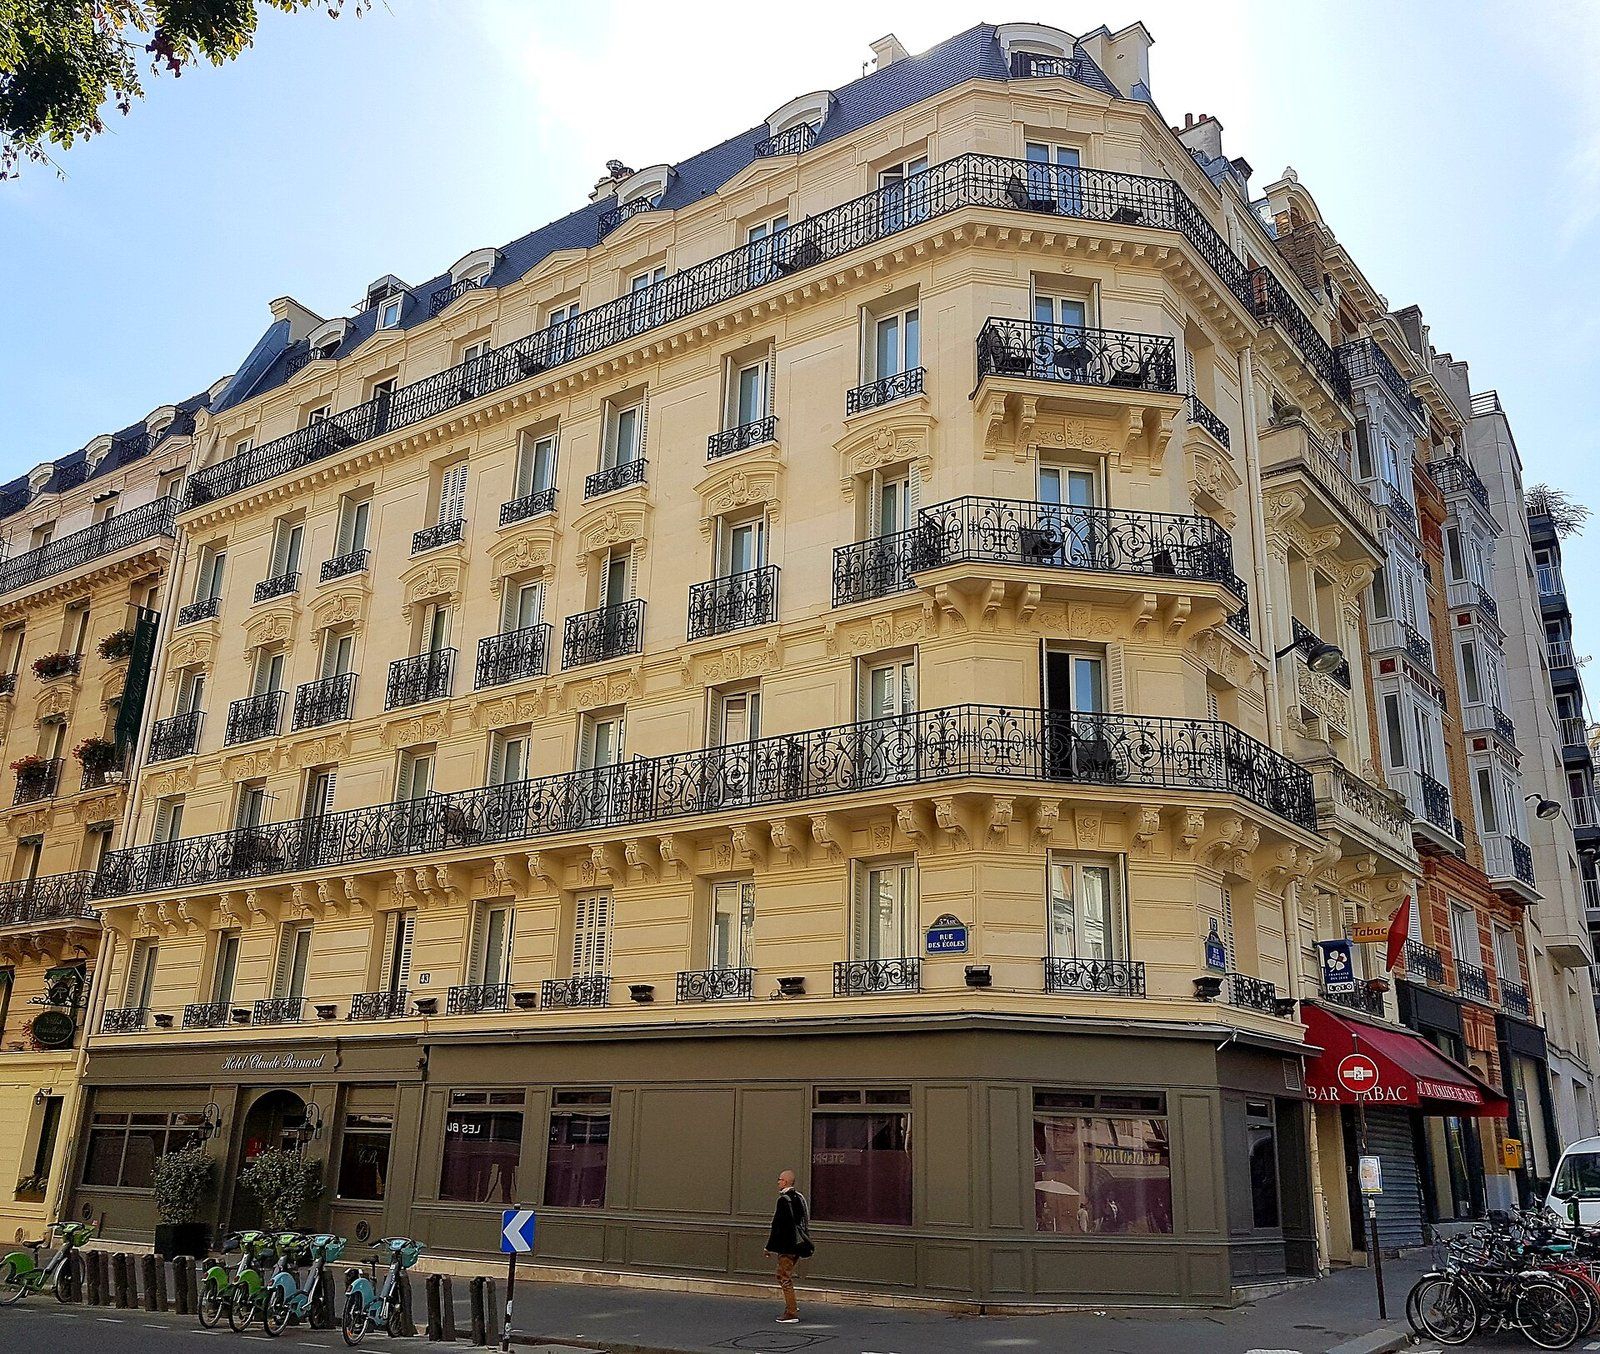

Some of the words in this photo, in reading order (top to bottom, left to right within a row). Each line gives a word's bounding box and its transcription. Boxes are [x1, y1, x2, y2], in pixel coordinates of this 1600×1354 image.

[1353, 926, 1388, 937] Tabac
[1328, 984, 1352, 992] LOTO
[250, 1053, 280, 1068] Claude
[282, 1053, 325, 1068] Bernard
[1307, 1086, 1340, 1101] BAR
